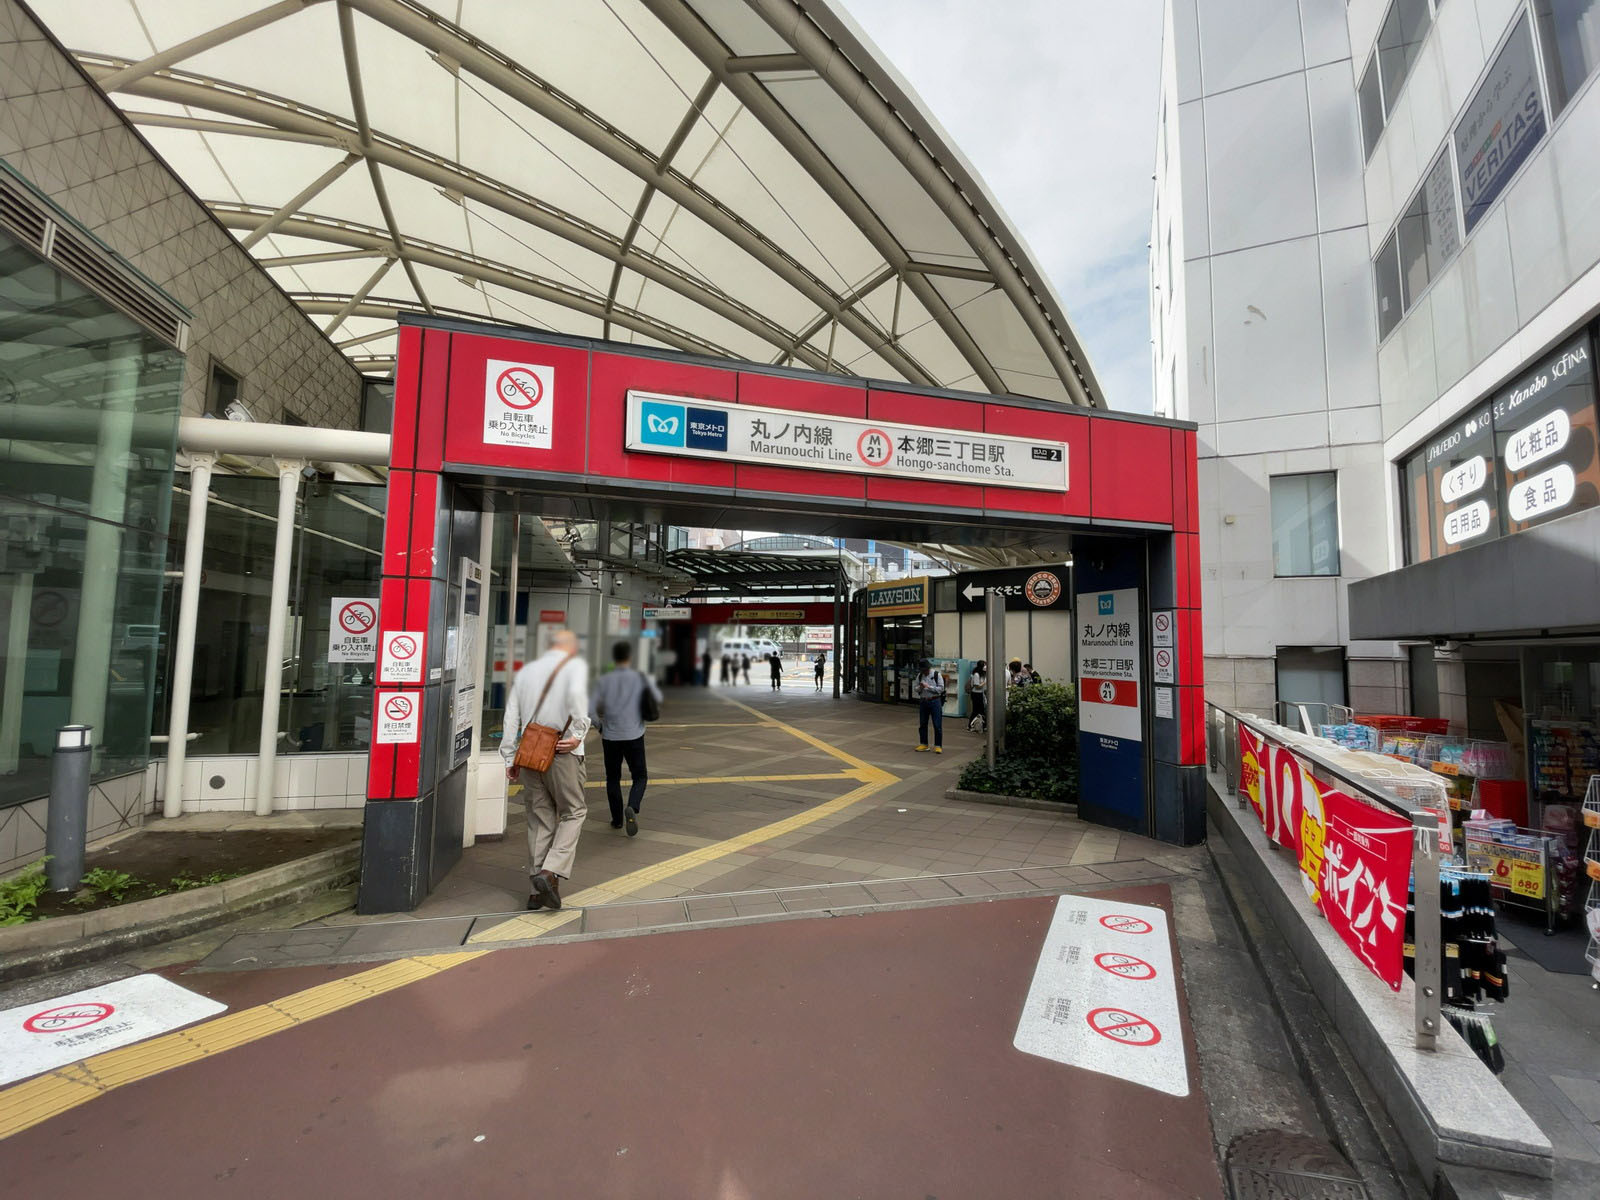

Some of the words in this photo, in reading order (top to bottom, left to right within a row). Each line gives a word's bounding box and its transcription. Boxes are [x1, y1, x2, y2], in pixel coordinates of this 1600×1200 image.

[1466, 91, 1538, 200] VERITAS
[1508, 375, 1547, 410] Kanebo
[1551, 347, 1587, 380] SOFINA
[503, 412, 534, 422] 自転車
[488, 419, 548, 434] 乗り入れ禁止
[690, 421, 725, 432] 東京メトロ
[692, 429, 707, 437] Tokyo
[750, 418, 833, 446] 丸ノ内線
[511, 431, 536, 439] Bicycles
[869, 434, 881, 446] M
[1515, 420, 1559, 462] 化粧品
[750, 440, 824, 459] Marunouchi
[828, 448, 853, 462] Line
[866, 446, 882, 459] 21
[897, 435, 1005, 463] 本郷三丁目駅
[1050, 450, 1058, 461] 2
[896, 455, 991, 475] Hongo-sanchome
[994, 464, 1015, 477] Sta.
[1448, 463, 1477, 494] くすり
[1524, 477, 1557, 511] 食品
[1450, 507, 1482, 536] 日用品
[870, 587, 921, 606] LAWSON
[1084, 622, 1131, 638] 丸ノ内線
[344, 636, 368, 644] 自転車
[1081, 639, 1119, 647] Marunouchi
[1119, 639, 1134, 647] Line
[1082, 658, 1134, 671] 本郷三丁目駅
[1082, 669, 1123, 677] Hongo-sanchome
[1102, 690, 1112, 699] 21
